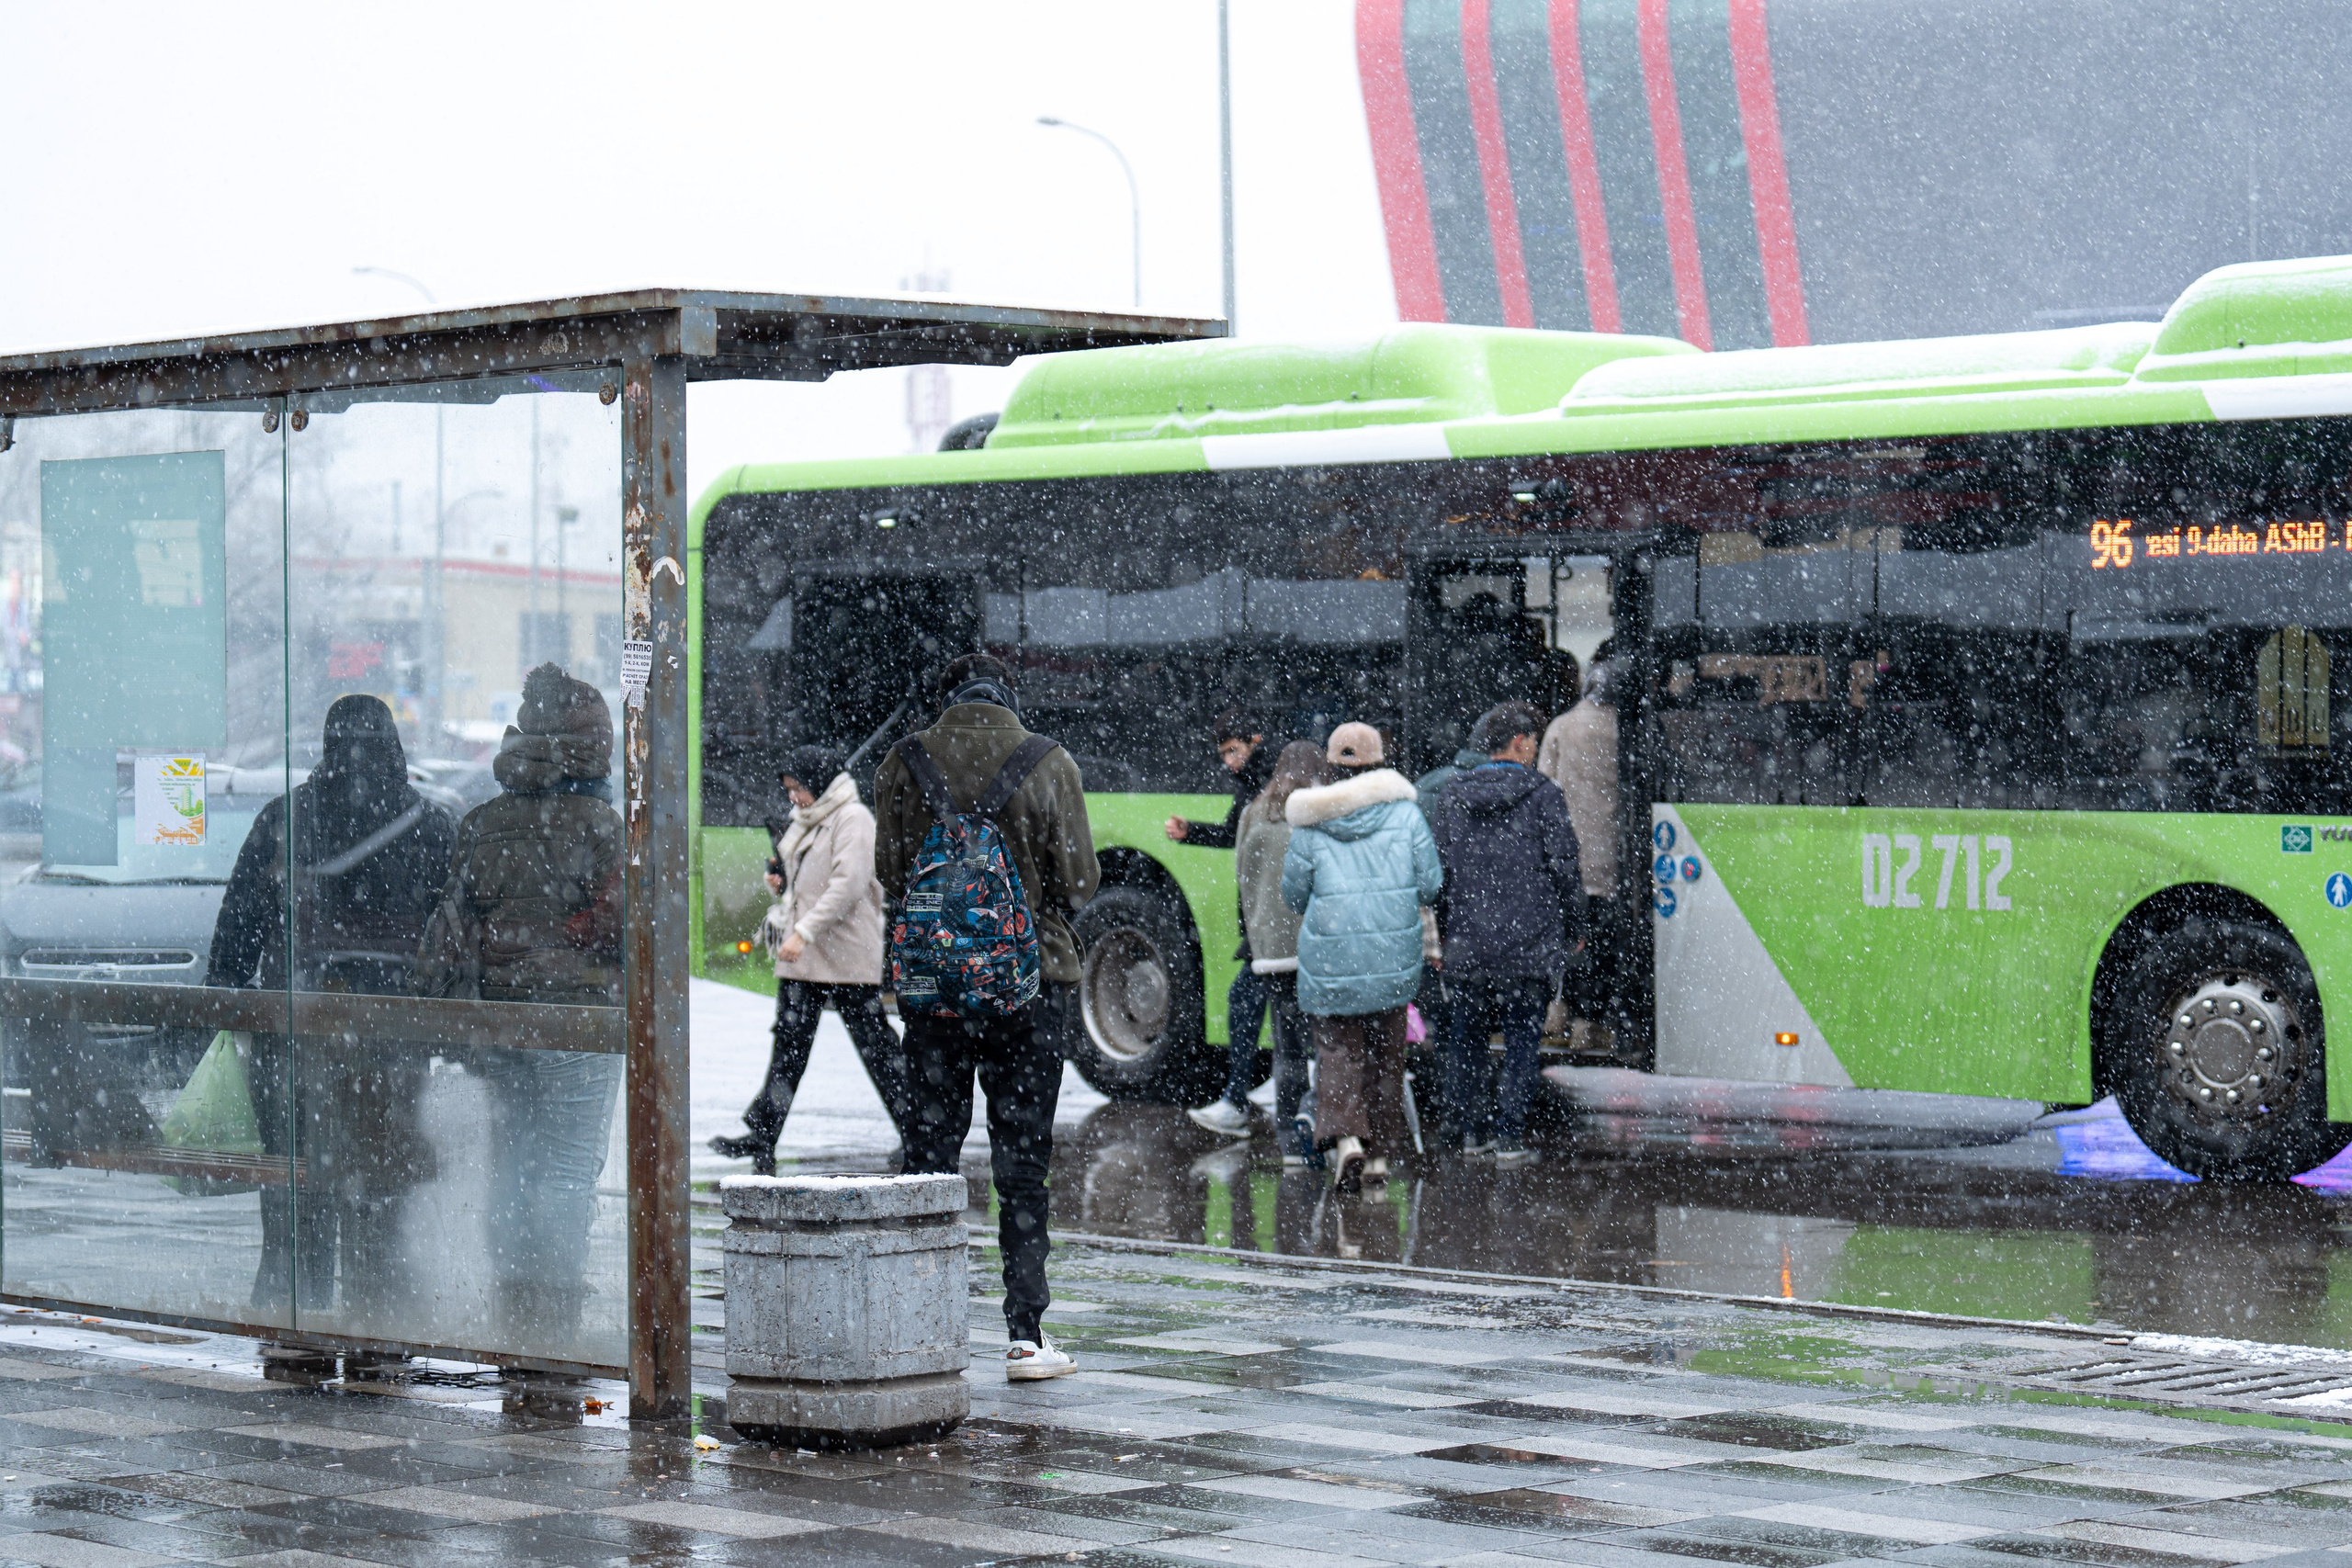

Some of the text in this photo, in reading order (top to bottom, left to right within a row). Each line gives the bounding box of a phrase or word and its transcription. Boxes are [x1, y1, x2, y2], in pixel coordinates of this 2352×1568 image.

[2090, 520, 2133, 568] 96
[2187, 525, 2258, 556] 9-daha
[2263, 521, 2325, 553] AShB
[624, 642, 651, 652] КУПЛЮ
[1861, 833, 2012, 910] 02 712
